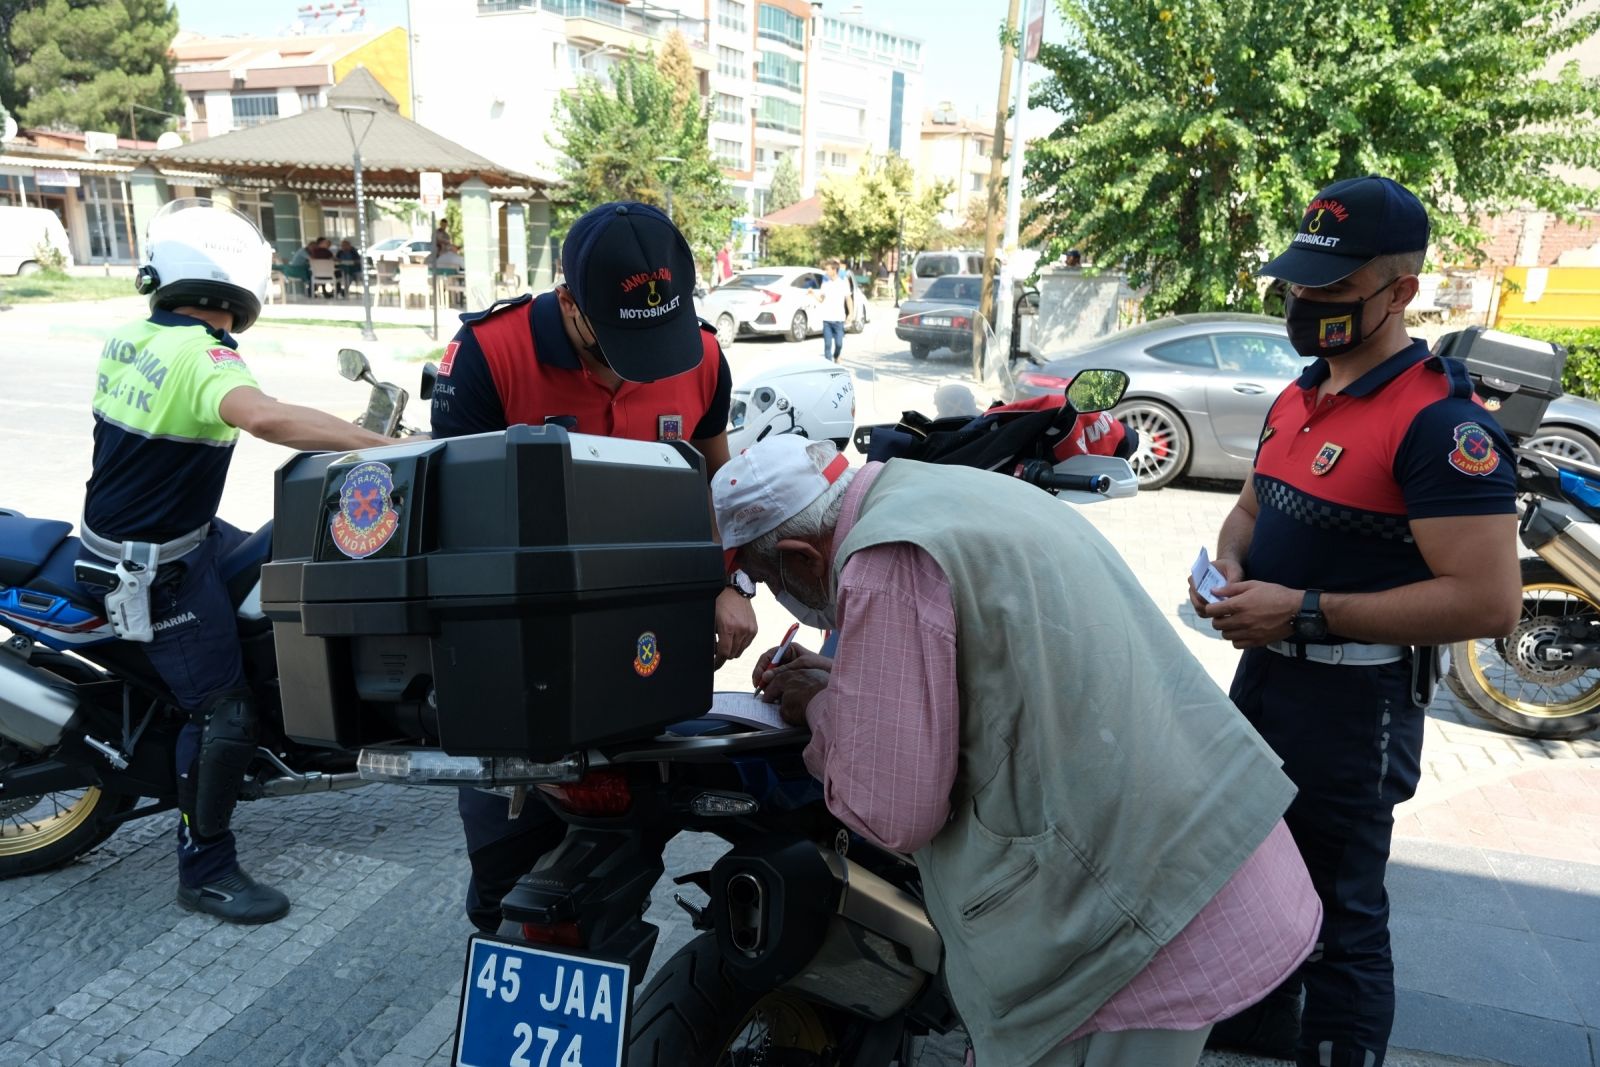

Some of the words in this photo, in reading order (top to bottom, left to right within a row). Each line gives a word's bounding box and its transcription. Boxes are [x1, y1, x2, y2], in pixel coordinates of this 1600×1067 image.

[832, 382, 854, 409] JAND
[335, 516, 395, 551] JANDARMA
[148, 611, 197, 632] NDARMA
[477, 953, 522, 1003] 45
[539, 966, 613, 1024] JAA
[509, 1022, 583, 1067] 274
